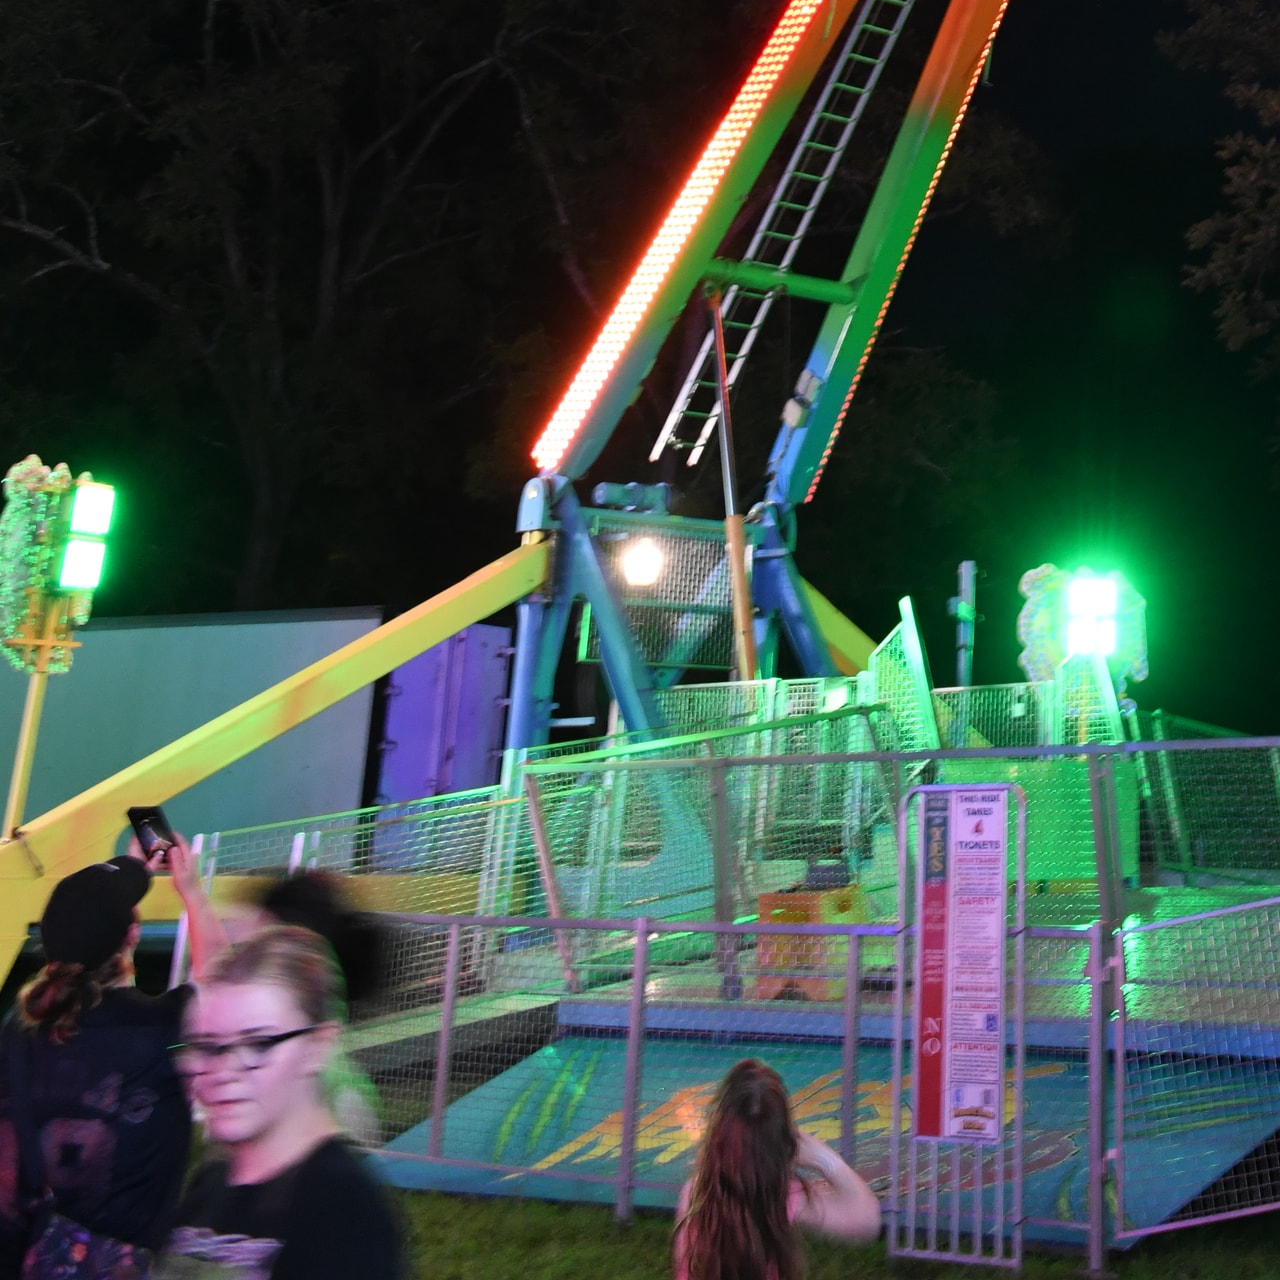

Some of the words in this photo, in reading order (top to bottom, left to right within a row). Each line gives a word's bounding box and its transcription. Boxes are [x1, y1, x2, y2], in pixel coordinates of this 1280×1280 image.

[959, 794, 978, 803] THIS
[981, 793, 1000, 803] RIDE
[966, 807, 993, 816] TAKES
[972, 819, 984, 836] 4
[928, 826, 946, 873] YES
[959, 840, 1001, 850] TICKETS
[959, 896, 998, 906] SAFETY
[952, 1042, 998, 1052] ATTENTION
